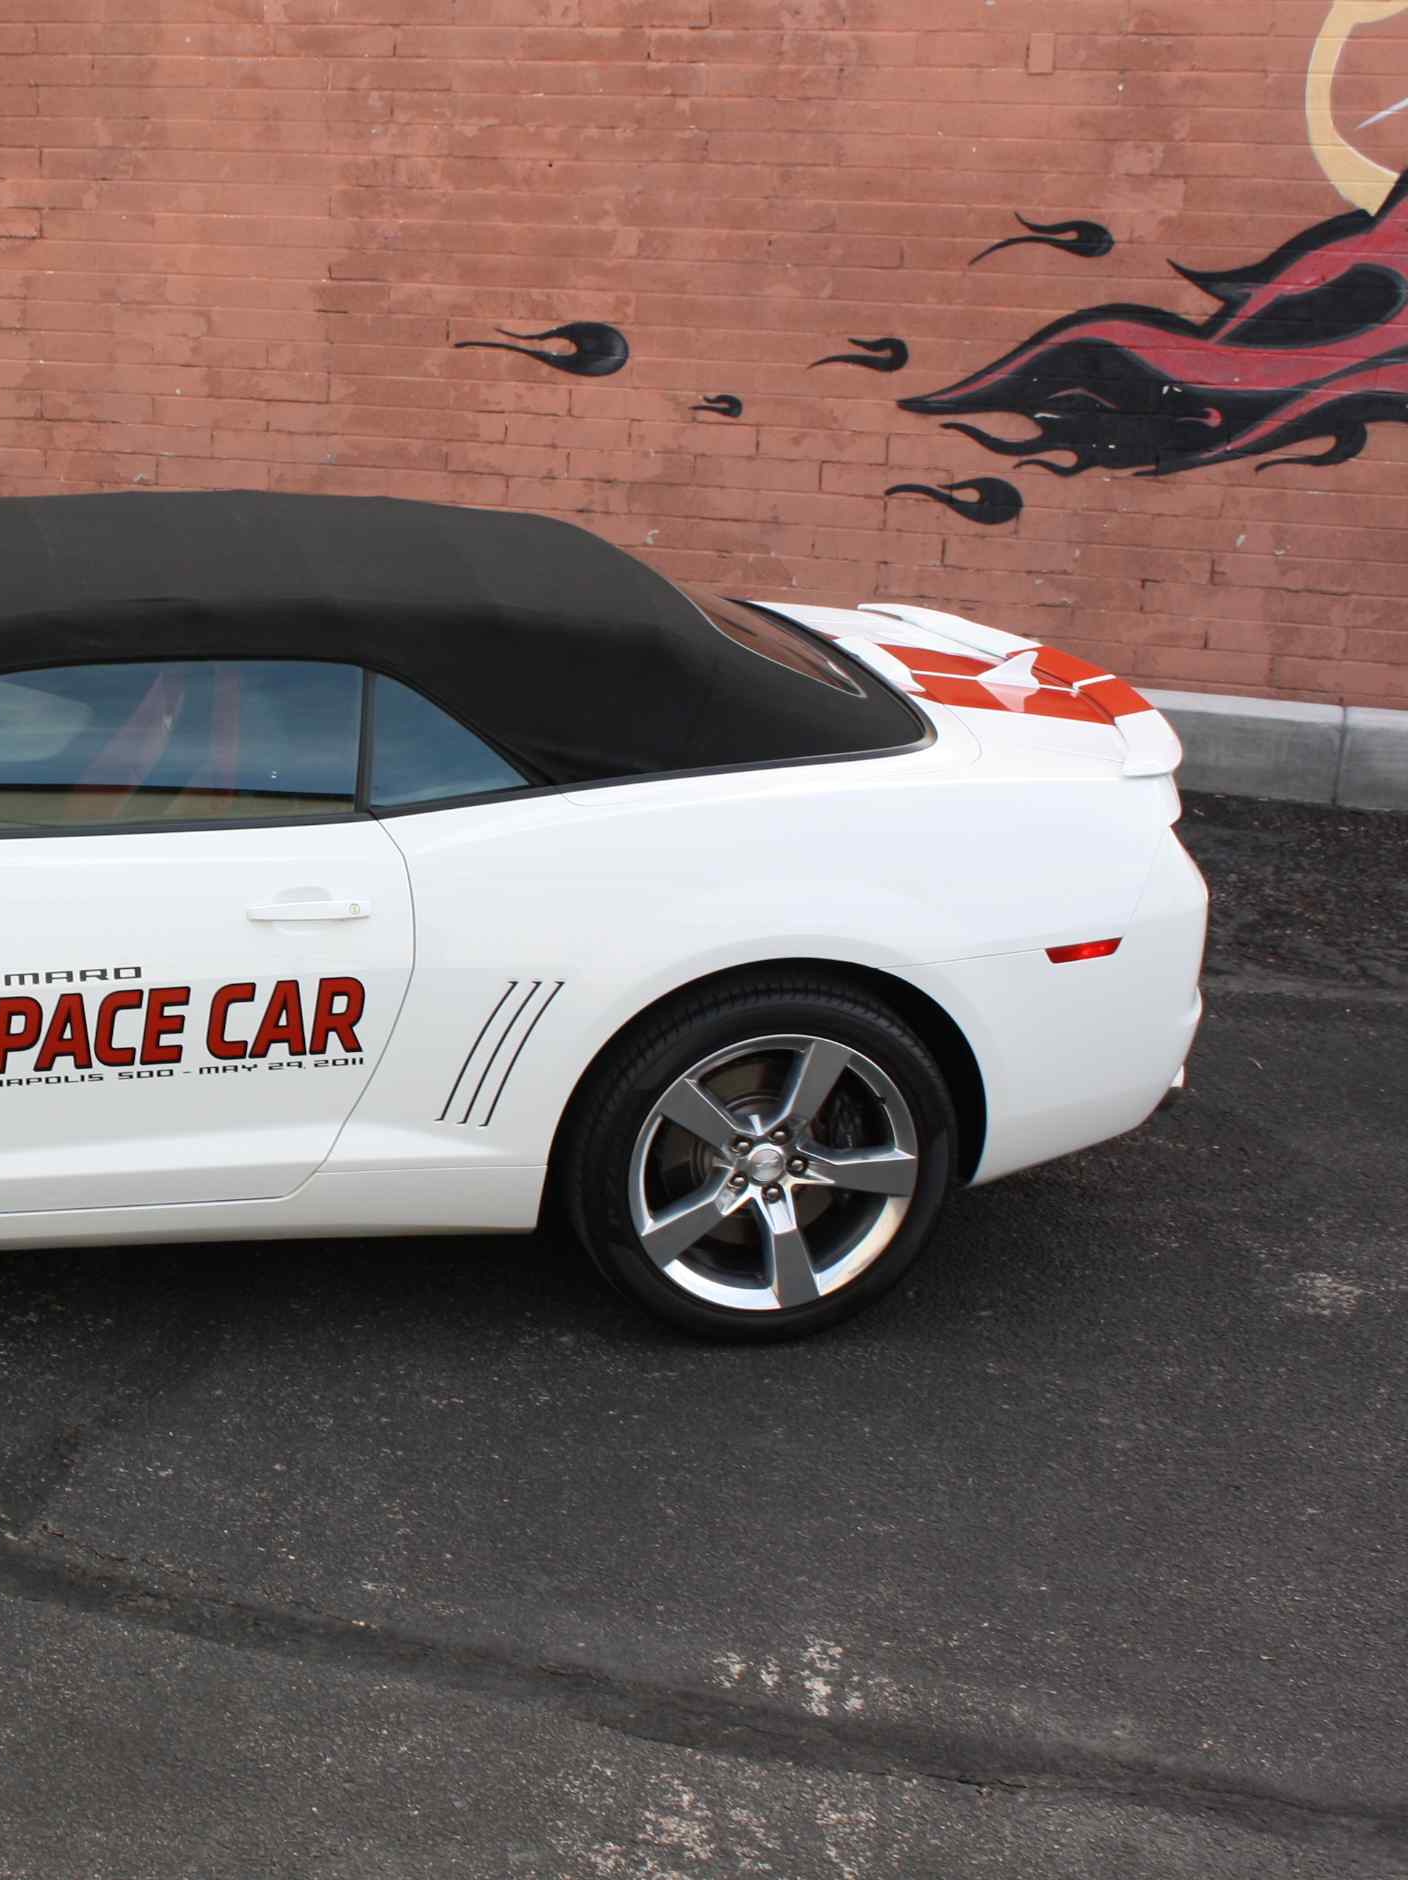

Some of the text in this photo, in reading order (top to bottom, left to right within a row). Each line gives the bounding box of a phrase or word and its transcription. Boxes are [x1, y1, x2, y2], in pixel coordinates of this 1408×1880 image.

[205, 976, 366, 1060] CAR
[117, 1068, 175, 1082] 500
[199, 1063, 259, 1077] MAY
[313, 1057, 365, 1068] 2011
